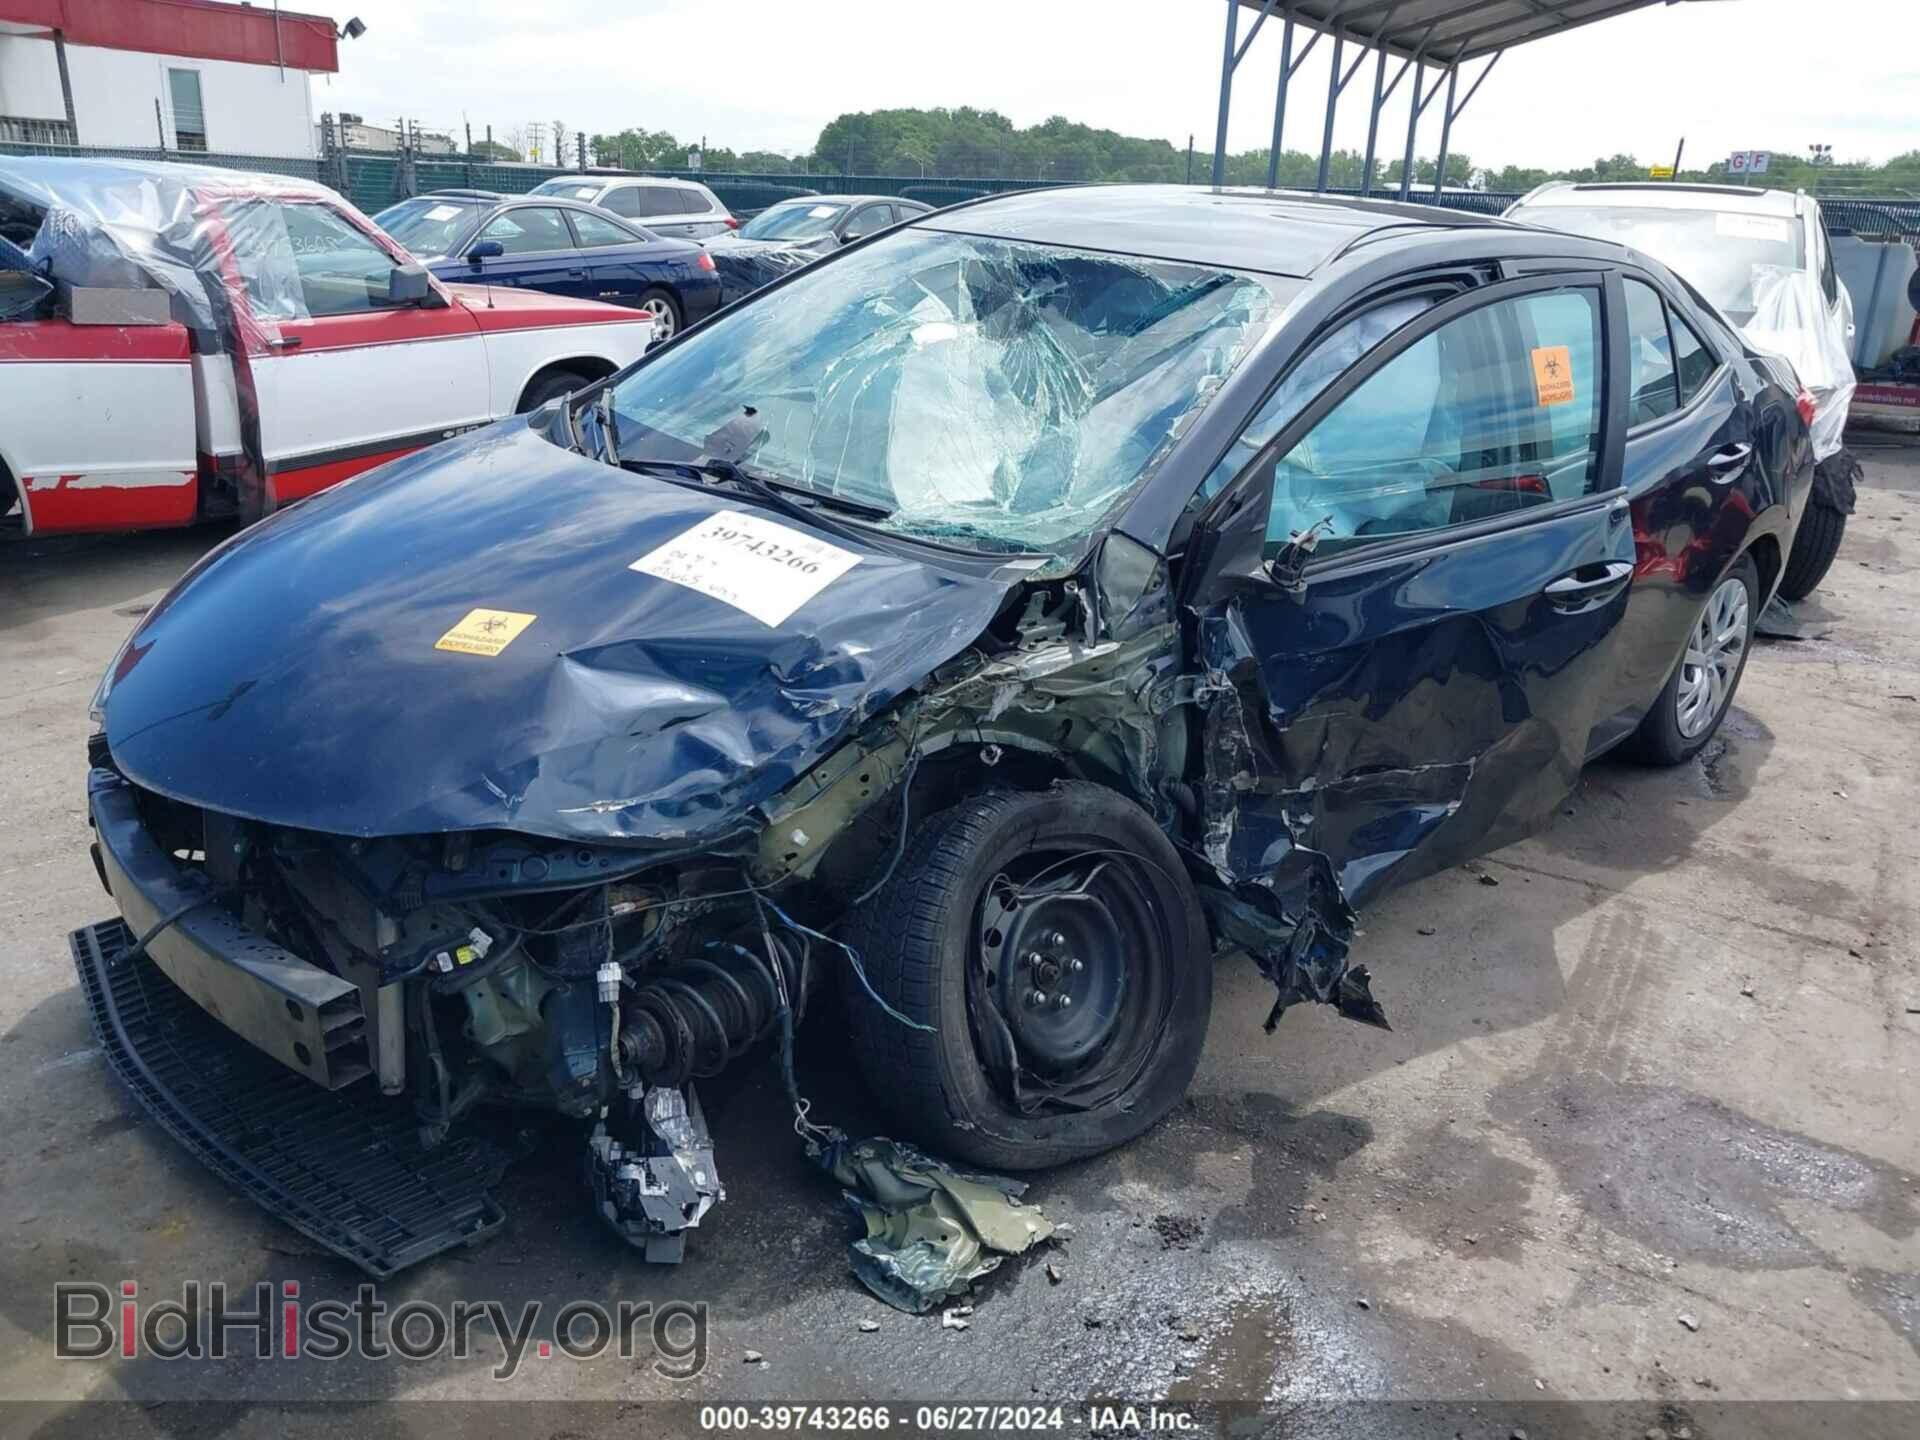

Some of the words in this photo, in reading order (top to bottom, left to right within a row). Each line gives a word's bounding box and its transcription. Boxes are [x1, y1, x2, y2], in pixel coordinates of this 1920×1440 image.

[1733, 154, 1744, 169] G
[1754, 154, 1765, 169] F
[702, 526, 821, 574] 39743266
